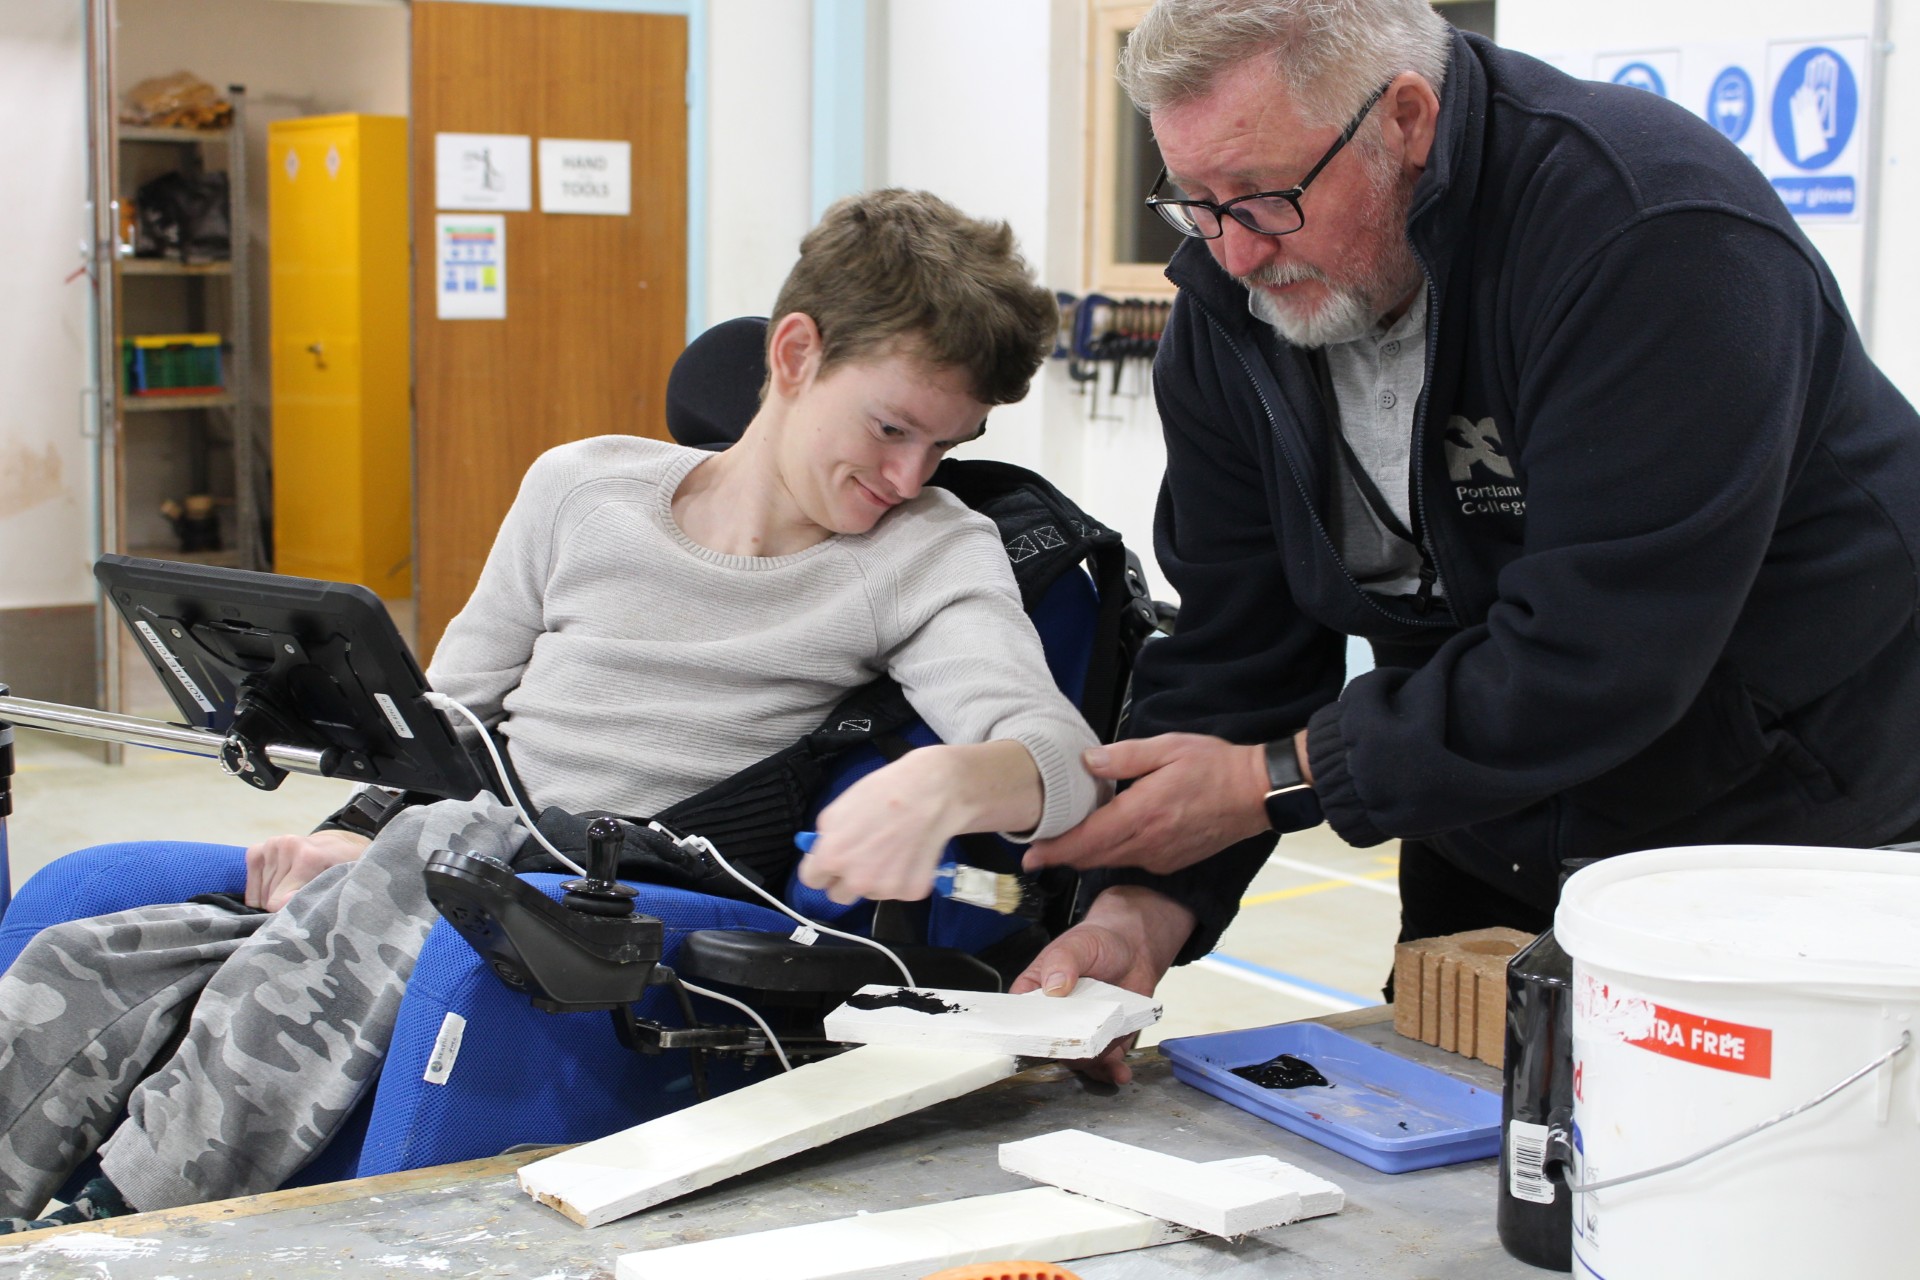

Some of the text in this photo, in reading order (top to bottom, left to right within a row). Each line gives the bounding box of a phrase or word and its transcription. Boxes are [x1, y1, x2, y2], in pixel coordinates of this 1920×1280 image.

[561, 155, 608, 171] HAND
[561, 182, 610, 198] TOOLS
[1774, 186, 1854, 208] ear gloves
[142, 627, 186, 679] FLETCHER
[1691, 1027, 1746, 1061] FREE
